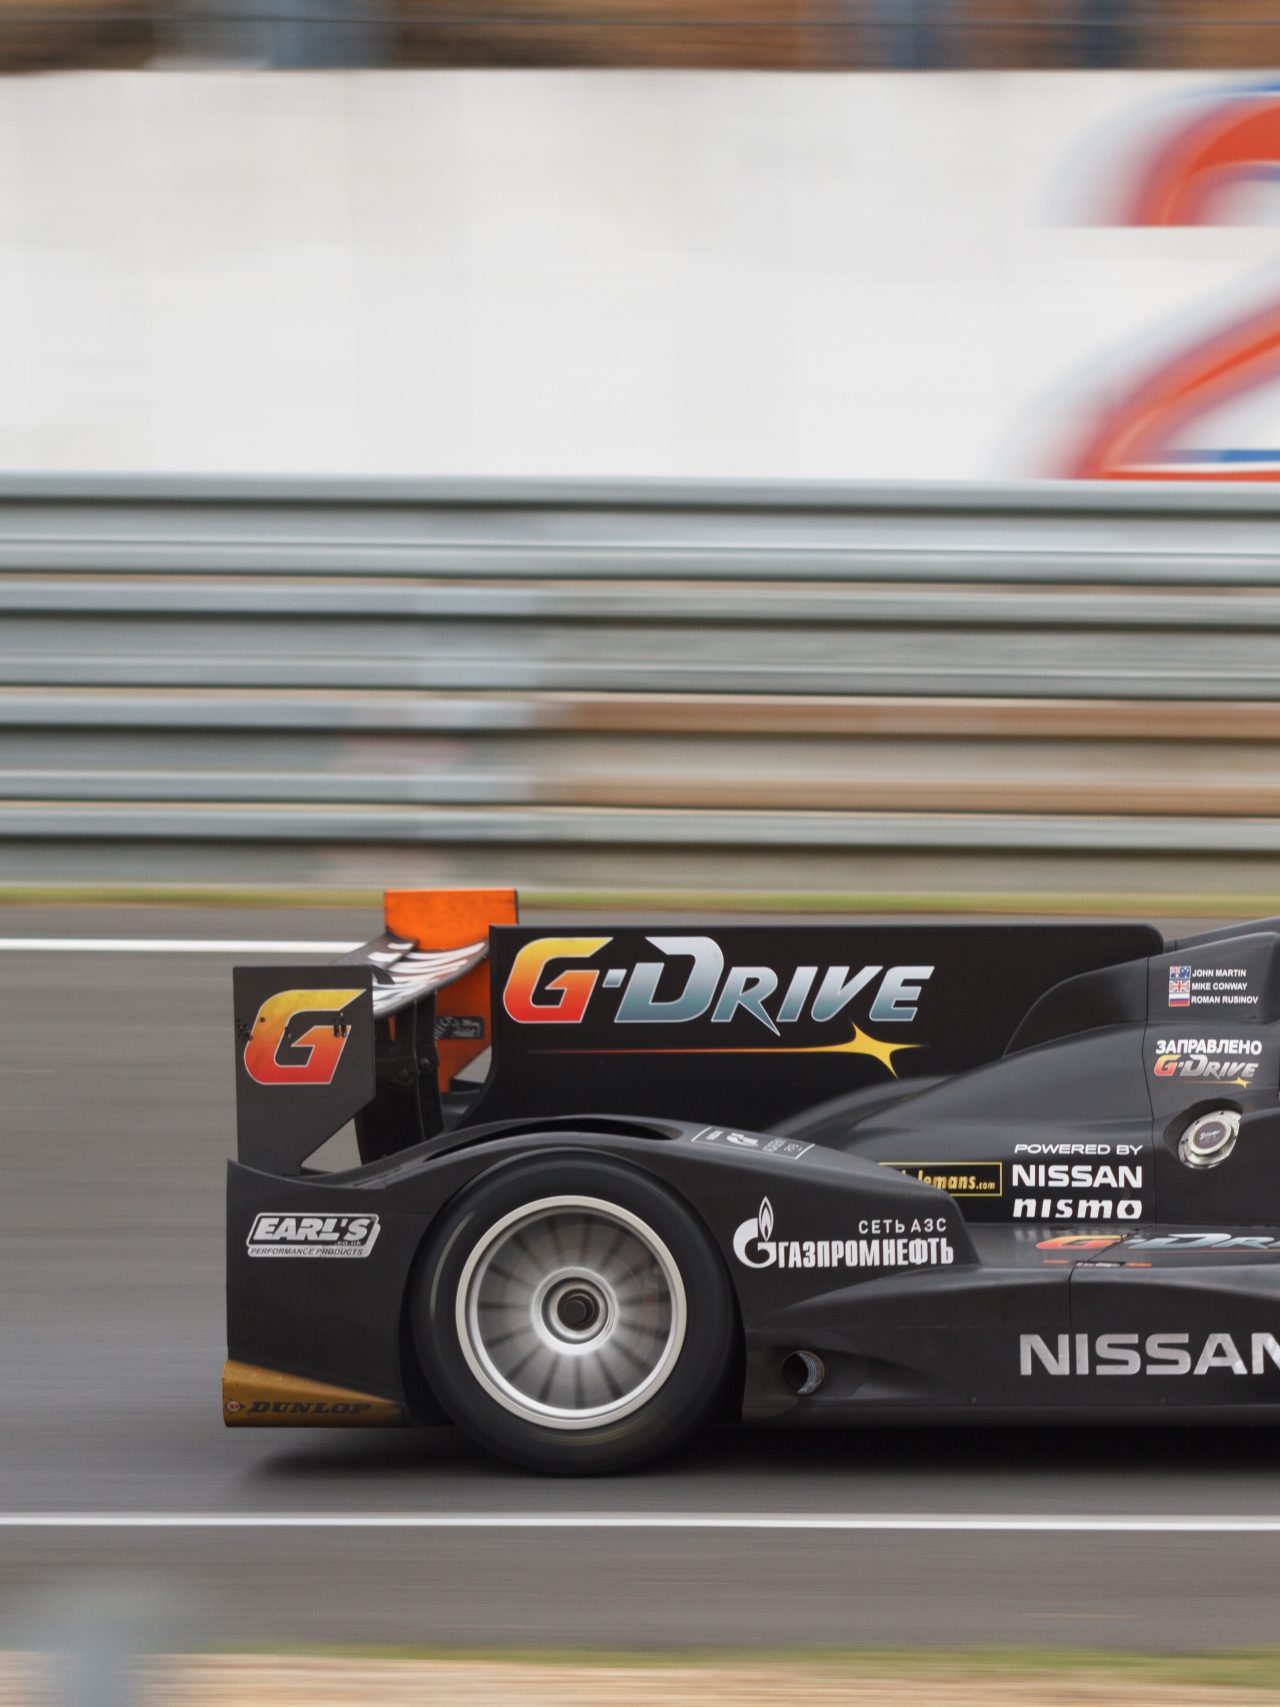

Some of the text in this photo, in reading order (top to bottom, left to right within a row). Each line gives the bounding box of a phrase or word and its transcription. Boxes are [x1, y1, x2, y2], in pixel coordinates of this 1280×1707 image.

[1192, 969, 1247, 978] JOHN MARTIN
[1192, 982, 1248, 991] MIKE CONWAY
[1191, 995, 1259, 1005] ROMAN RUSINOV
[243, 988, 366, 1085] G
[1156, 1038, 1263, 1055] ЗАПРАВЛЕНО
[1014, 1144, 1143, 1156] POWERED BY
[1012, 1165, 1143, 1189] NISSAN
[1012, 1199, 1143, 1219] nismo
[253, 1218, 371, 1241] EARL'S
[858, 1217, 947, 1234] СЕТЬ АЗС
[251, 1247, 363, 1256] PERFORMANCE PRODUCTS
[779, 1237, 954, 1269] ГАЗПРОМНЕФТЬ
[248, 1401, 373, 1414] DUNLOP
